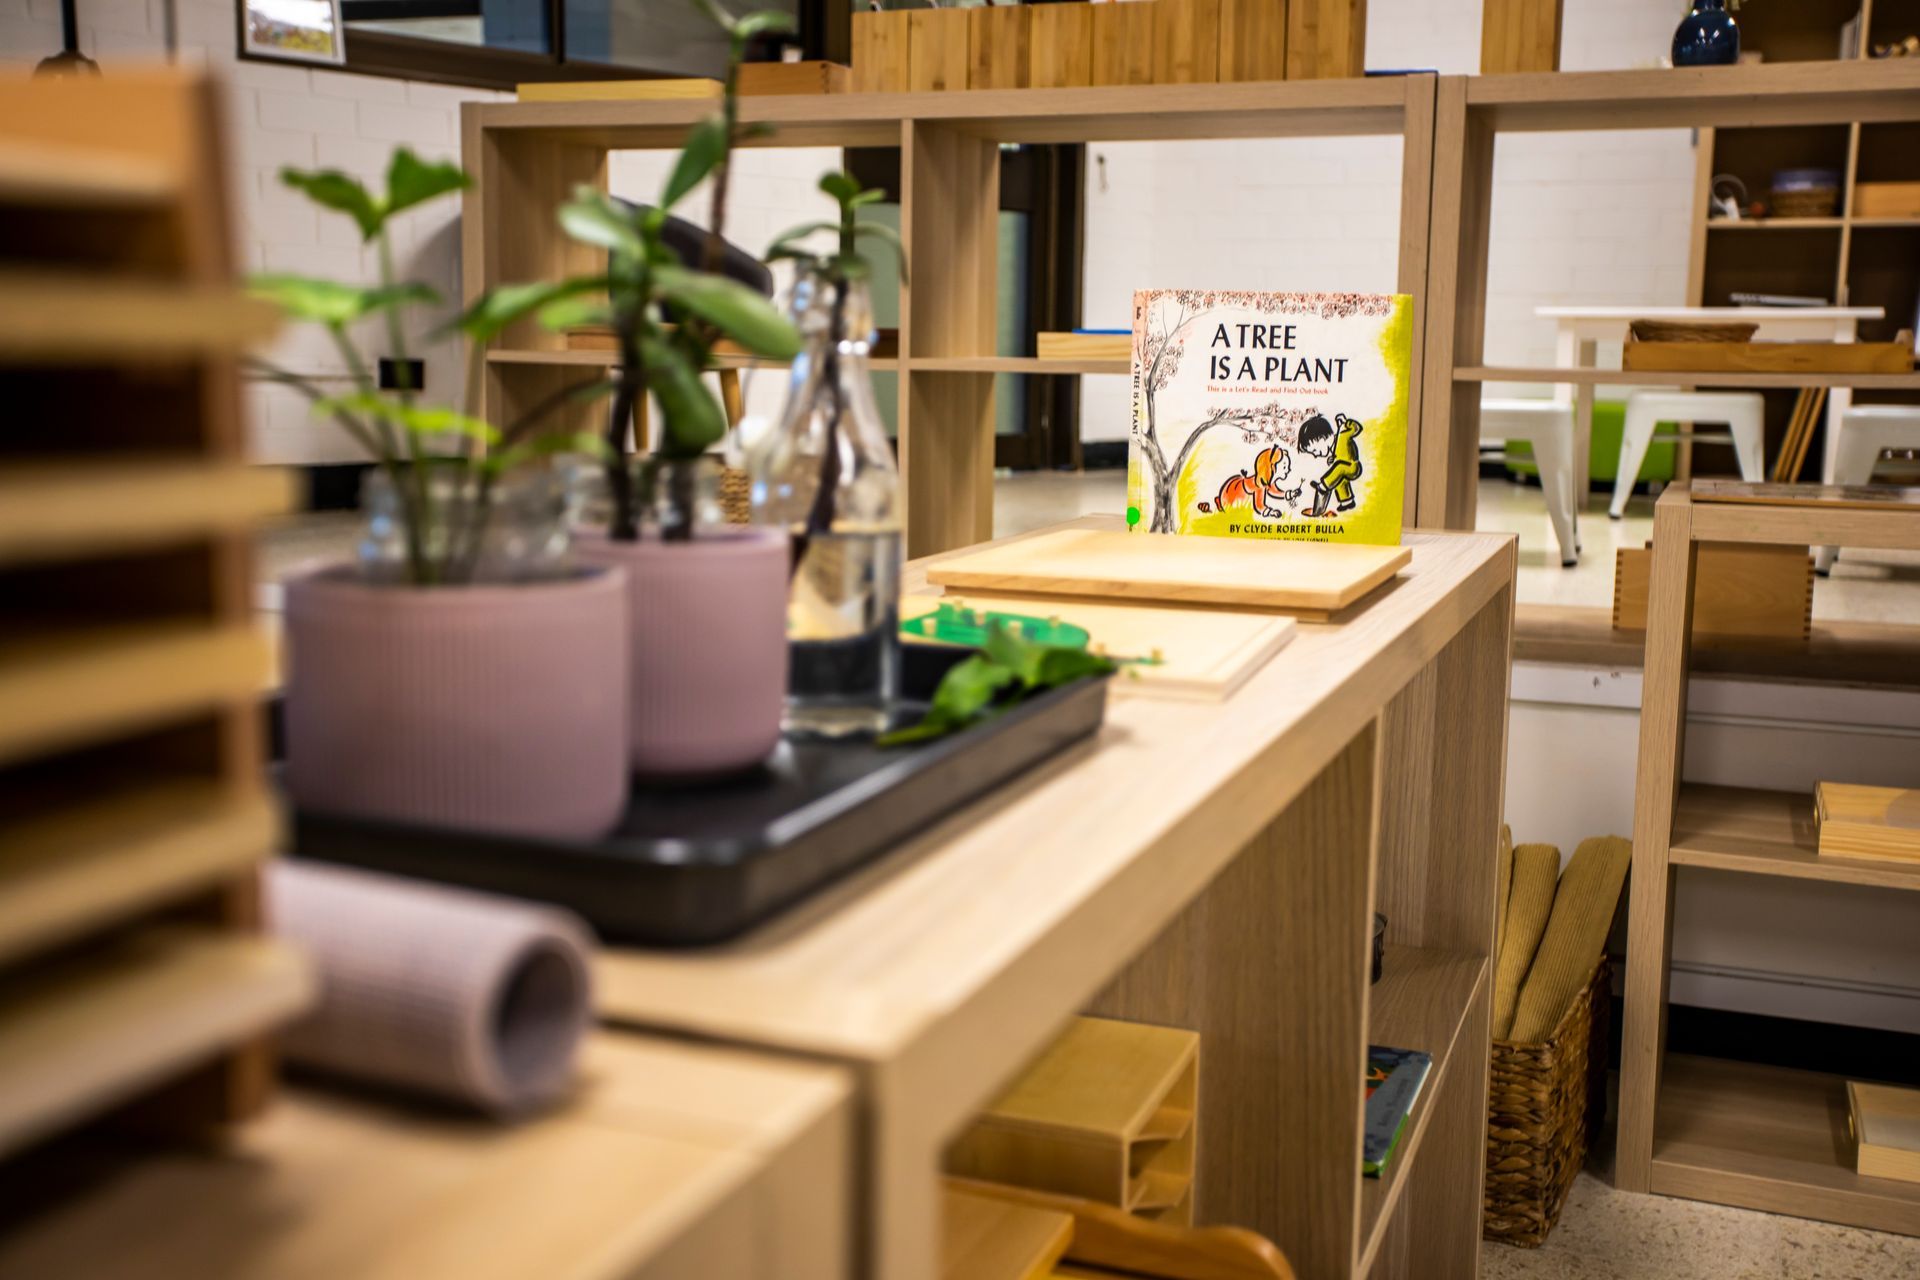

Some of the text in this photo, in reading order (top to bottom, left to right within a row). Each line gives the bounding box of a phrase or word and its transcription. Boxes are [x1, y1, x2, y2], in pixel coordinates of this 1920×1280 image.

[1211, 323, 1297, 350] A TREE
[1210, 355, 1349, 383] IS A PLANT
[1133, 391, 1139, 399] IS
[1207, 385, 1220, 393] This
[1251, 385, 1268, 393] Read
[1269, 385, 1281, 394] and
[1229, 524, 1345, 535] BY CLYDE ROBERT BULLA
